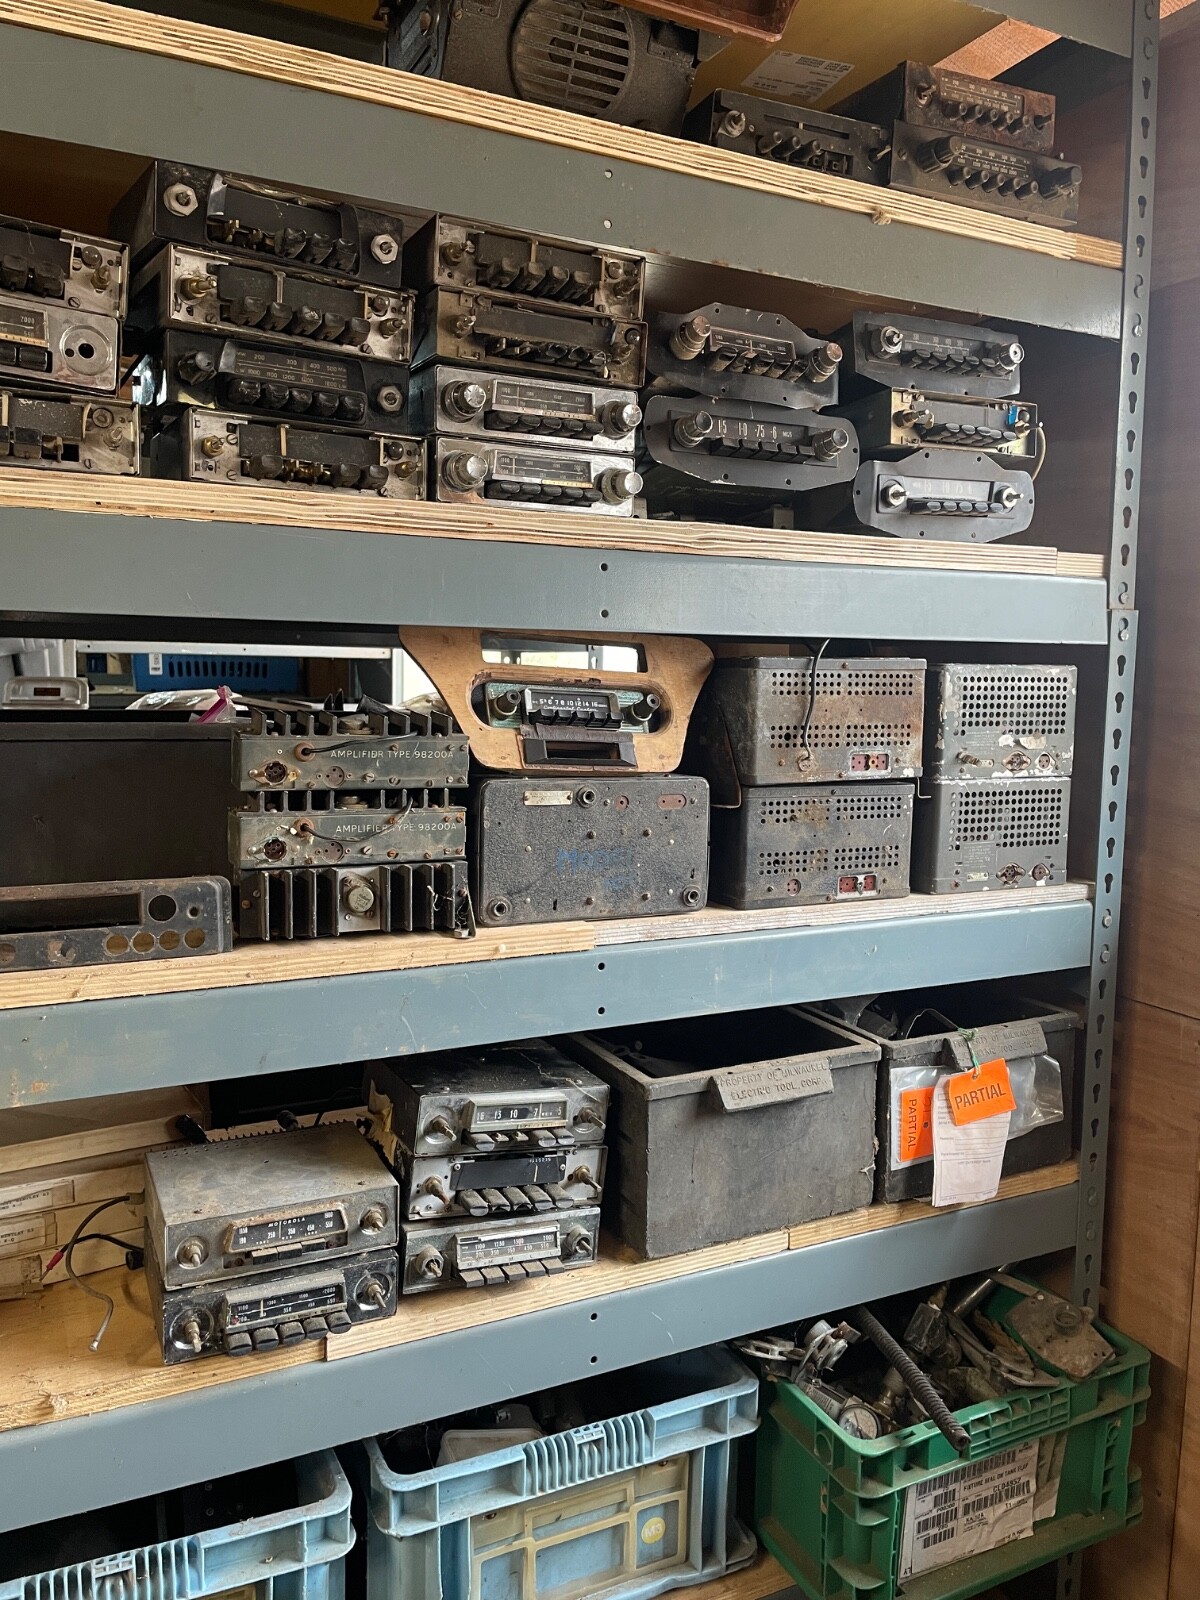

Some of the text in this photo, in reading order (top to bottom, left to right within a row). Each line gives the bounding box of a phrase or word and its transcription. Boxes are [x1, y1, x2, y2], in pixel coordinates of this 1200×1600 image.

[331, 750, 454, 758] AMPLIFIER TYPE 98200A
[418, 823, 457, 831] 98200A
[955, 1083, 1006, 1110] PARTIAL
[908, 1099, 917, 1151] PARTIAL
[268, 1217, 305, 1228] MOOROLA
